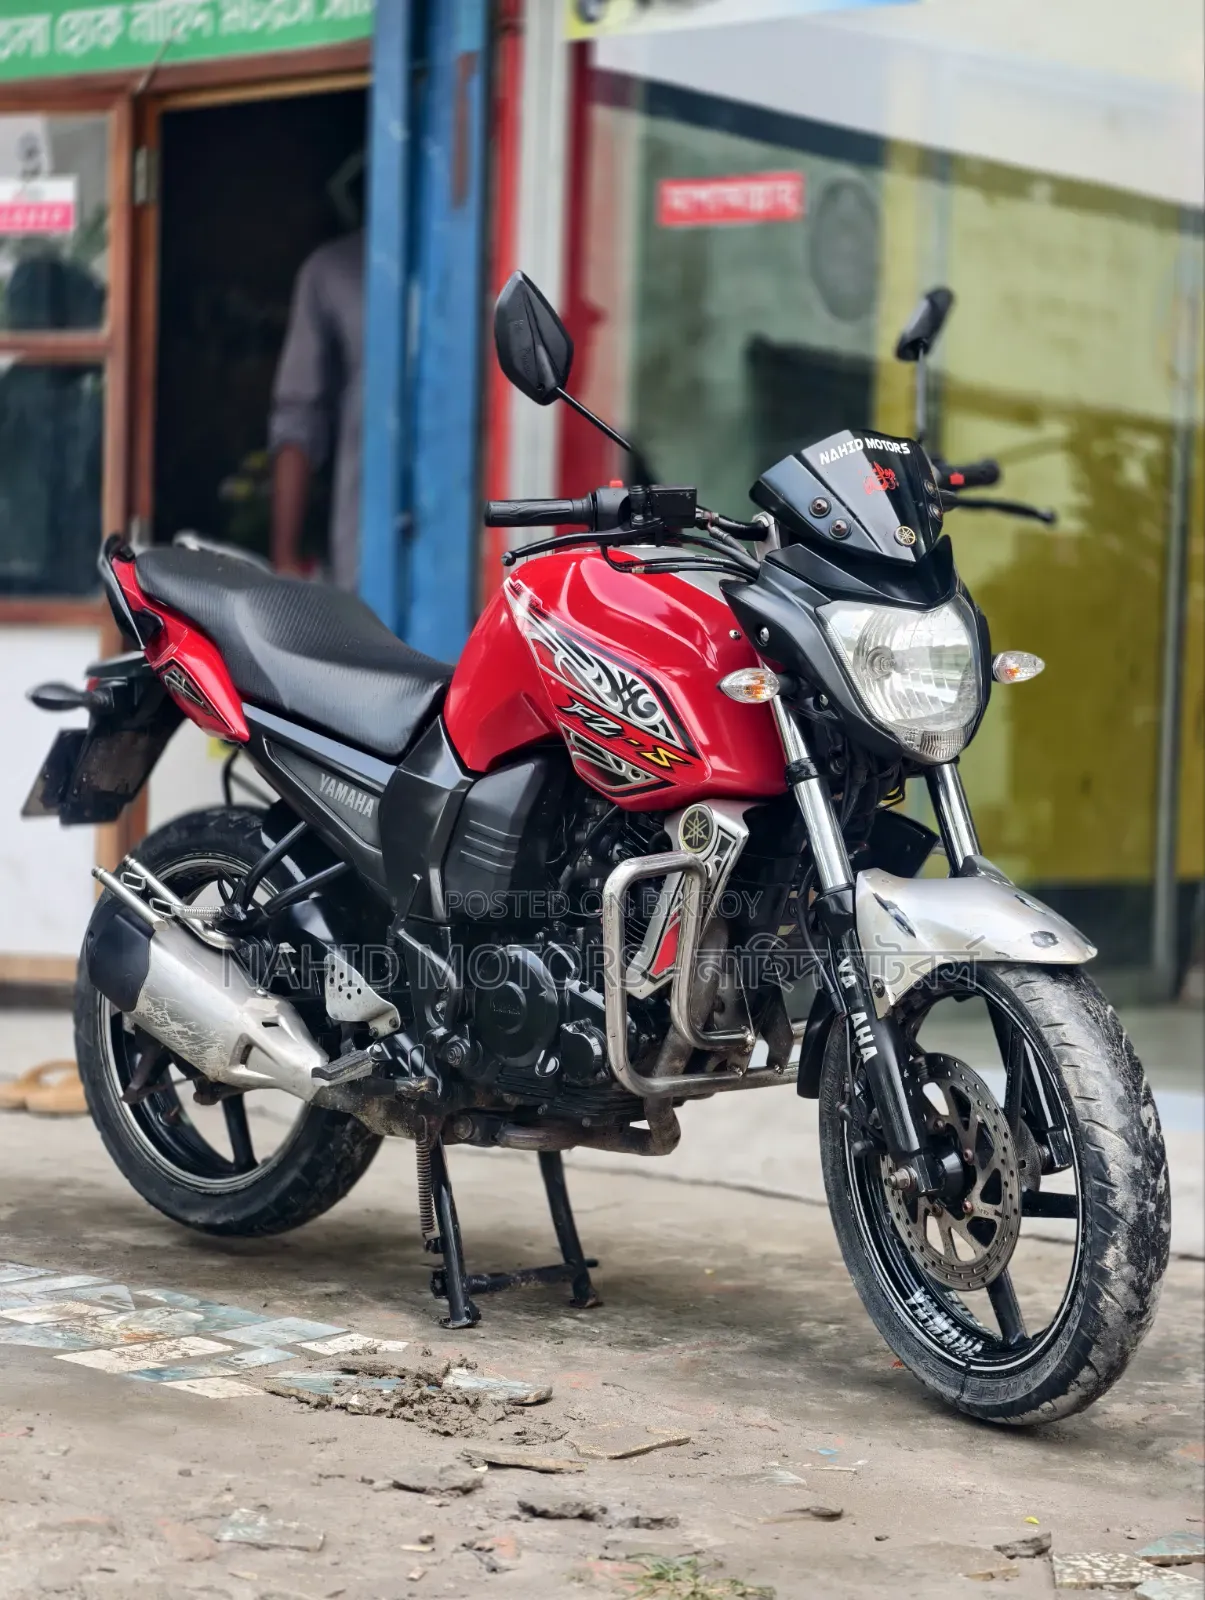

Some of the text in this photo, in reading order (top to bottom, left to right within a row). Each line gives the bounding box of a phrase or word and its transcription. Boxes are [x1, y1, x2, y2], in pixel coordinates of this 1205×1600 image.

[819, 437, 911, 466] NAHID MOTORS
[319, 773, 375, 819] YAMAHA
